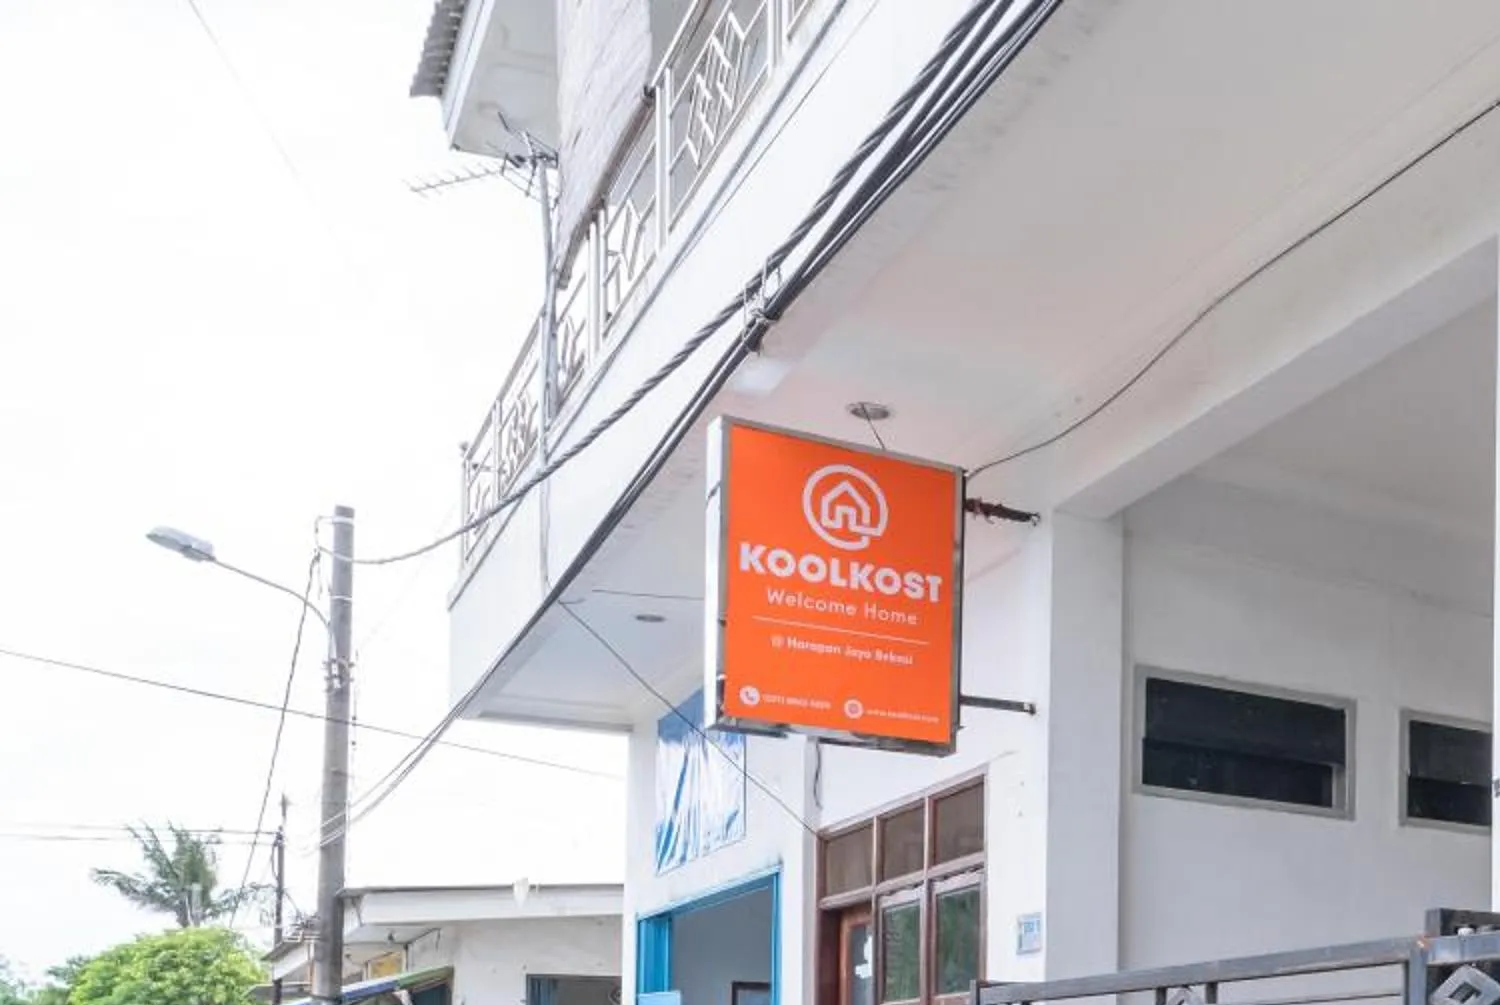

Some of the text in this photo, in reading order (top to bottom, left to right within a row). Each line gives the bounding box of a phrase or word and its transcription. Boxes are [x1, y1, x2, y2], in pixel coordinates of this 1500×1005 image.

[739, 543, 942, 602] KOOLKOST
[767, 588, 917, 625] Welcome Home
